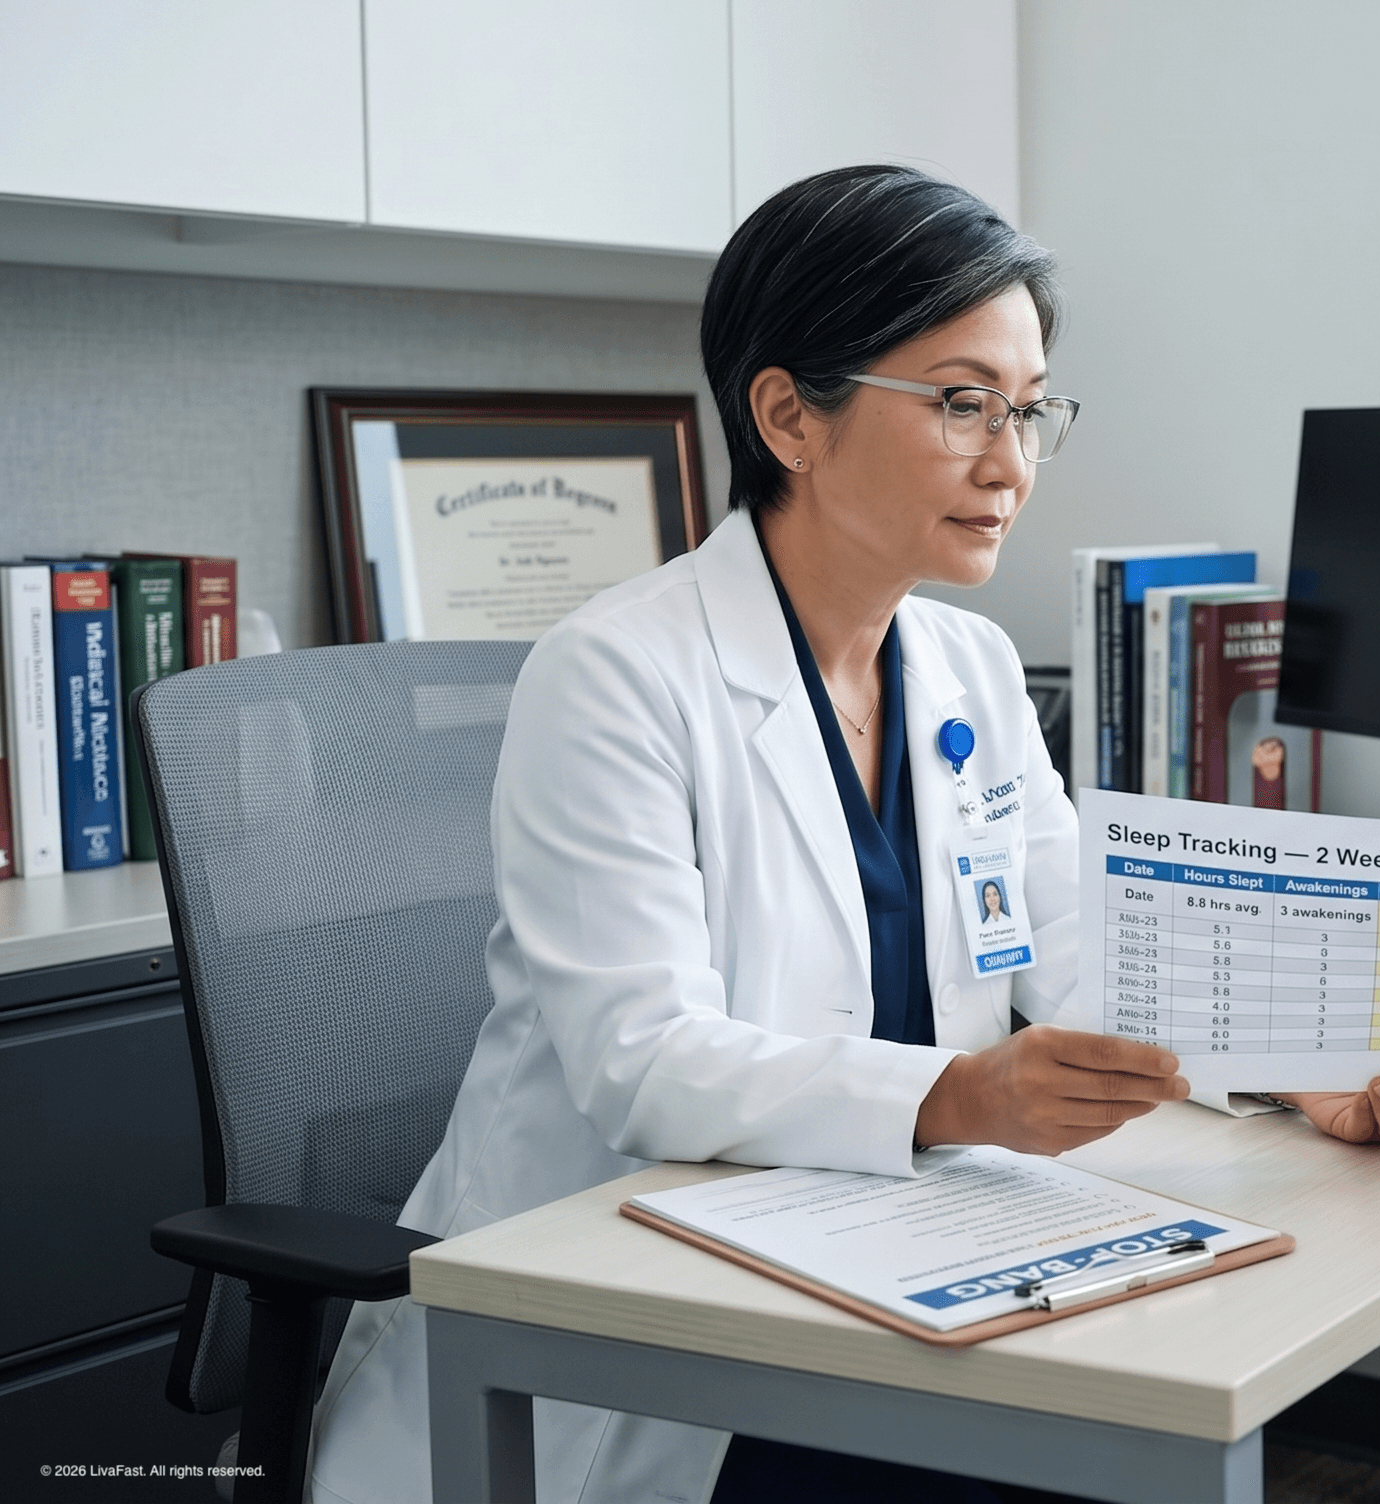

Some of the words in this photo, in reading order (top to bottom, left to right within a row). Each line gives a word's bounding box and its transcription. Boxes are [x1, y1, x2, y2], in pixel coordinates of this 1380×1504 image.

[1107, 823, 1170, 851] Sleep
[1178, 832, 1277, 863] Tracking
[1317, 847, 1328, 863] 2
[1124, 862, 1154, 876] Date
[1184, 869, 1224, 884] Hours
[1229, 875, 1263, 890] Slept
[1285, 879, 1368, 896] Awakenings
[1125, 888, 1154, 902] Date
[1187, 897, 1206, 908] 8.8
[1211, 899, 1231, 911] hrs
[1235, 903, 1262, 916] avg.
[1280, 906, 1288, 915] 3
[1292, 908, 1371, 922] awakenings
[1321, 934, 1328, 942] 3
[1213, 940, 1231, 950] 5.6
[1213, 956, 1230, 965] 5.8
[1320, 963, 1327, 971] 3
[1213, 972, 1230, 981] 5.3
[1319, 991, 1325, 999] 3
[1213, 1002, 1230, 1011] 4.0
